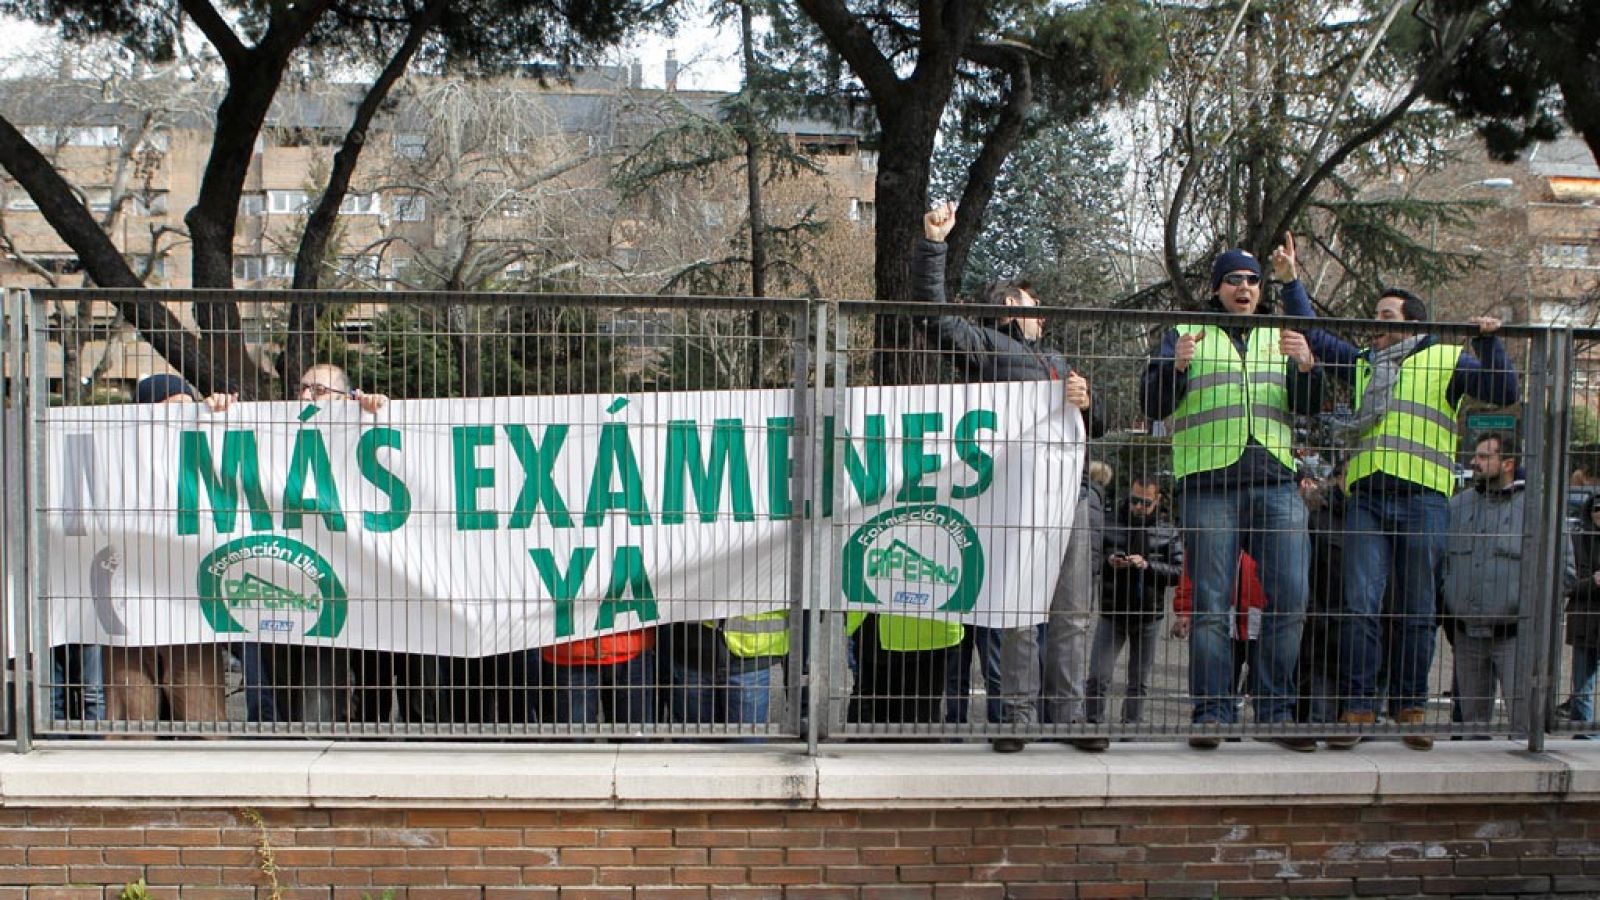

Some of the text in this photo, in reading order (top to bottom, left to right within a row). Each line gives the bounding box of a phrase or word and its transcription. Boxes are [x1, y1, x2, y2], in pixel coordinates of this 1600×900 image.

[177, 403, 412, 536] MÁS
[452, 396, 998, 531] EXÁMENES
[528, 546, 660, 638] YA
